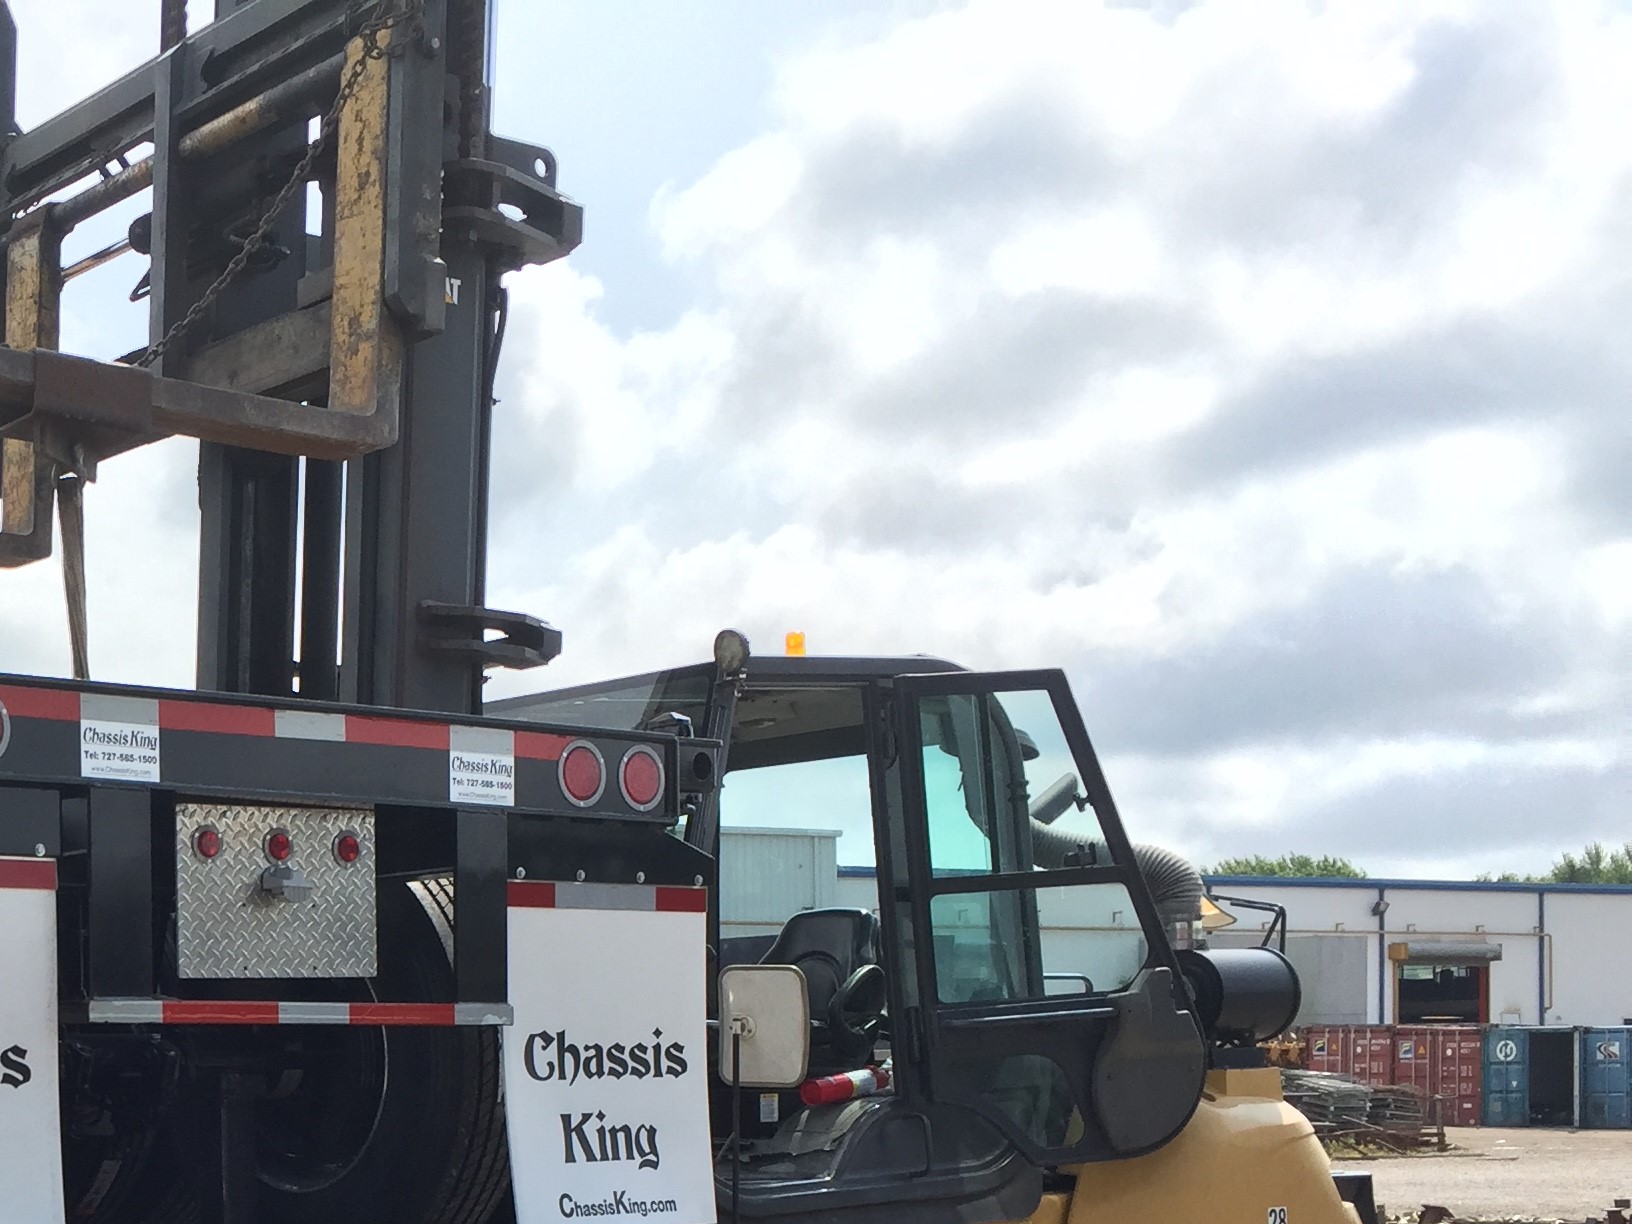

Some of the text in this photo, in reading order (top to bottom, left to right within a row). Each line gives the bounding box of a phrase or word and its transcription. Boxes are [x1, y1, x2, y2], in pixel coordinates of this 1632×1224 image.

[83, 727, 158, 751] Chassis King
[452, 756, 513, 778] Chassis King
[524, 1027, 688, 1087] Chassis
[559, 1110, 660, 1171] King
[559, 1190, 678, 1219] ChassisKing.com
